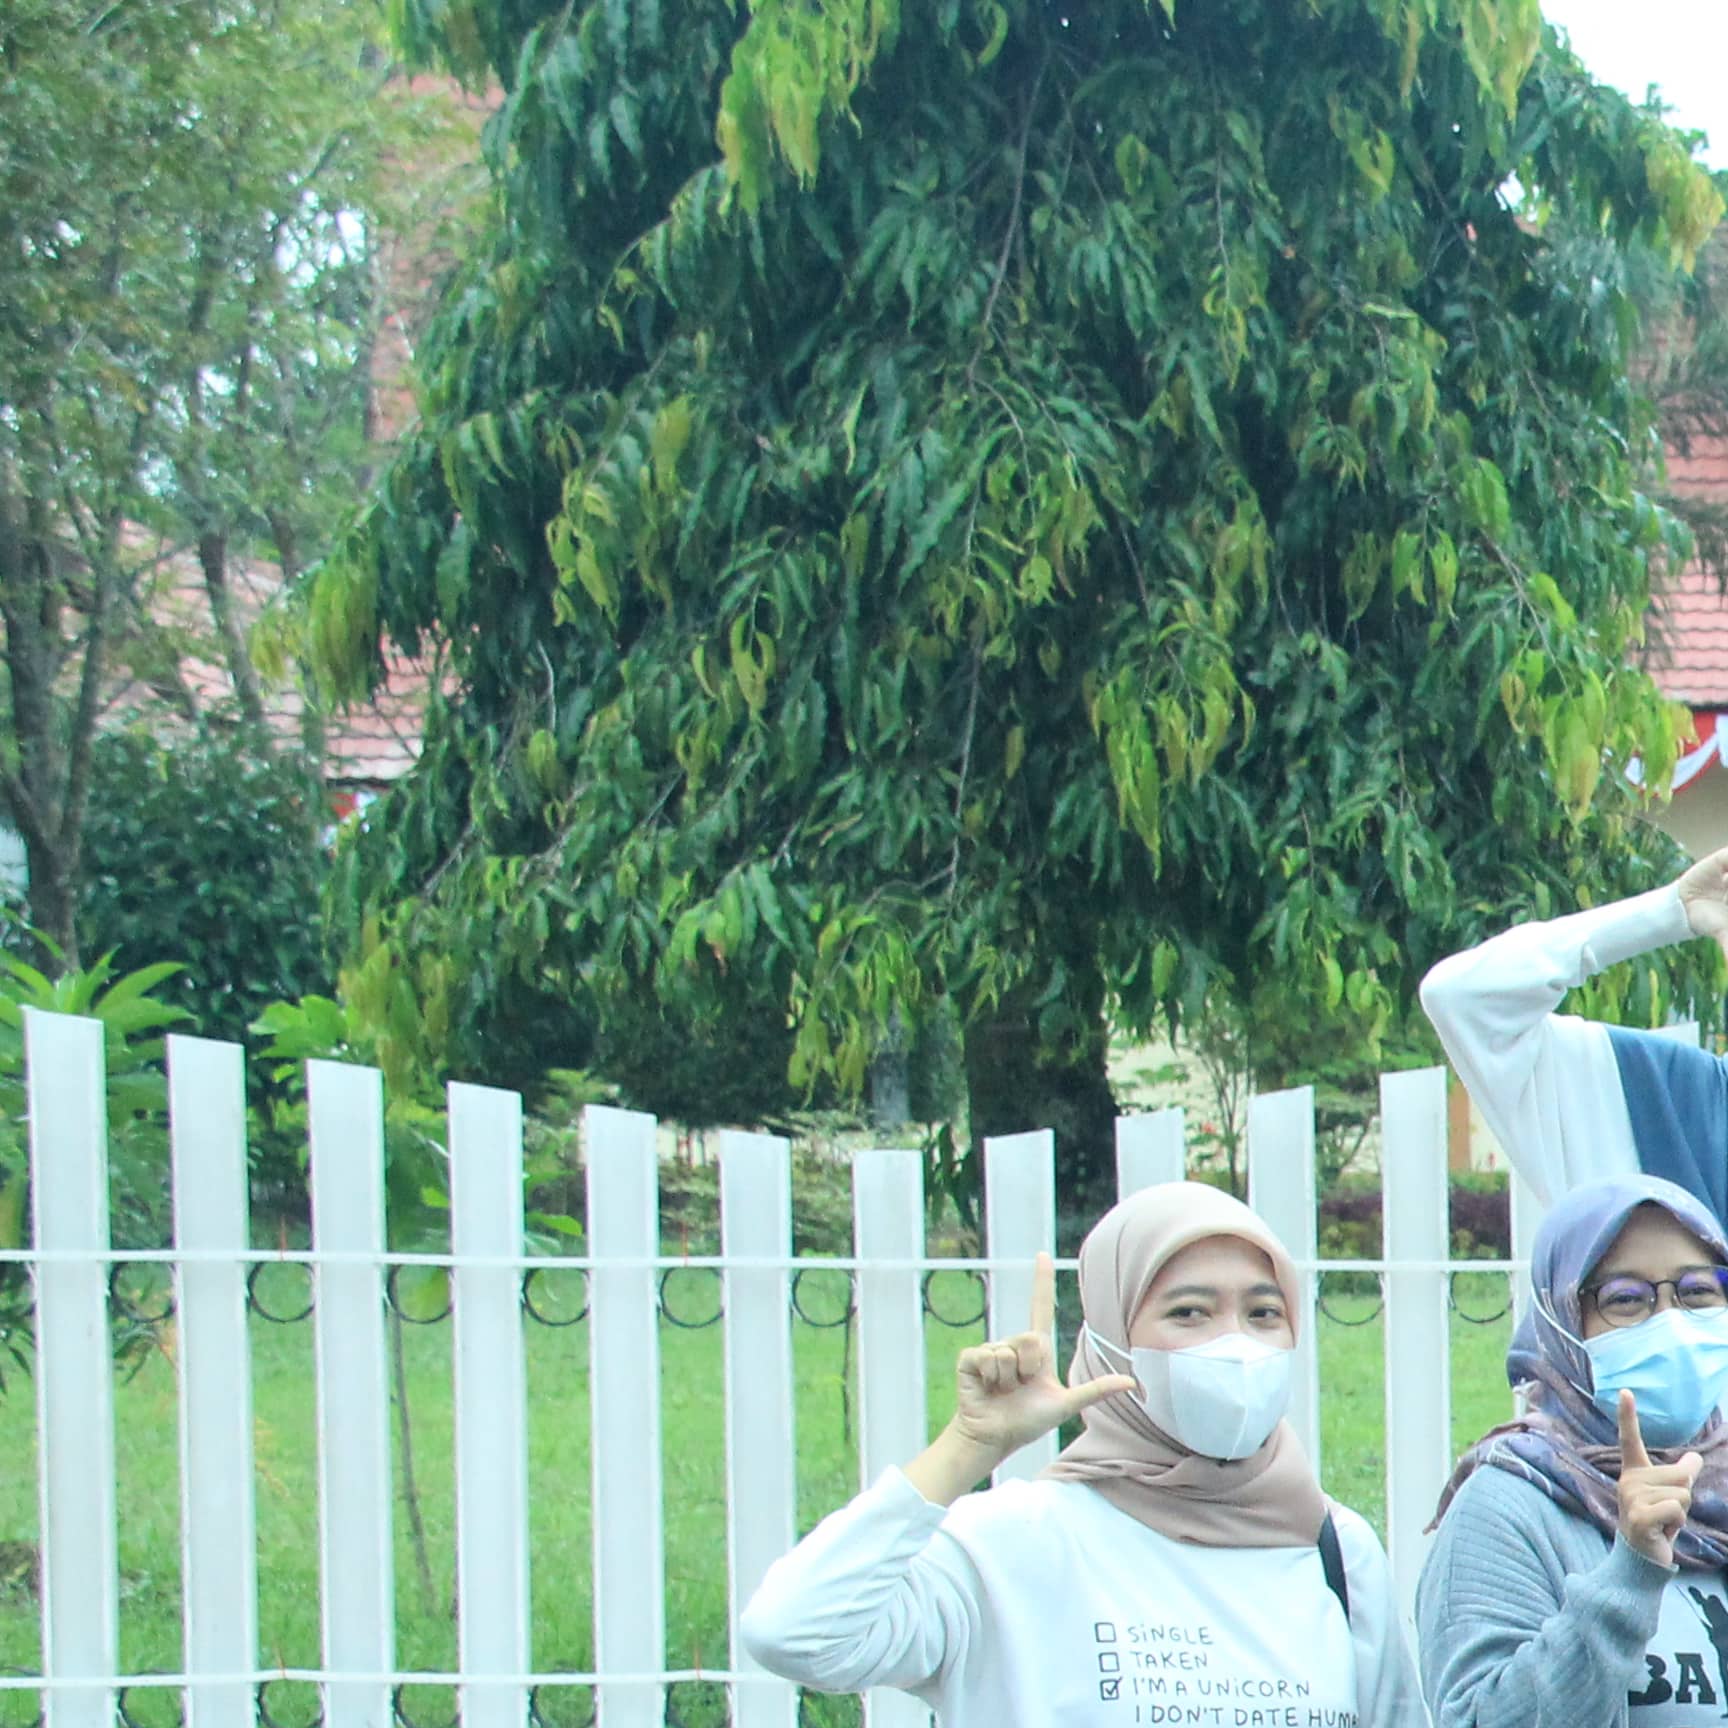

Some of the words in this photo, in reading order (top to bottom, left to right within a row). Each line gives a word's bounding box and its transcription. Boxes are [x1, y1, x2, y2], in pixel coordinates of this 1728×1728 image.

[1129, 1650, 1208, 1671] TAKEN
[1175, 1680, 1188, 1697] A
[1135, 1706, 1141, 1724] I
[1150, 1704, 1225, 1726] DON'T
[1234, 1707, 1299, 1728] DATE
